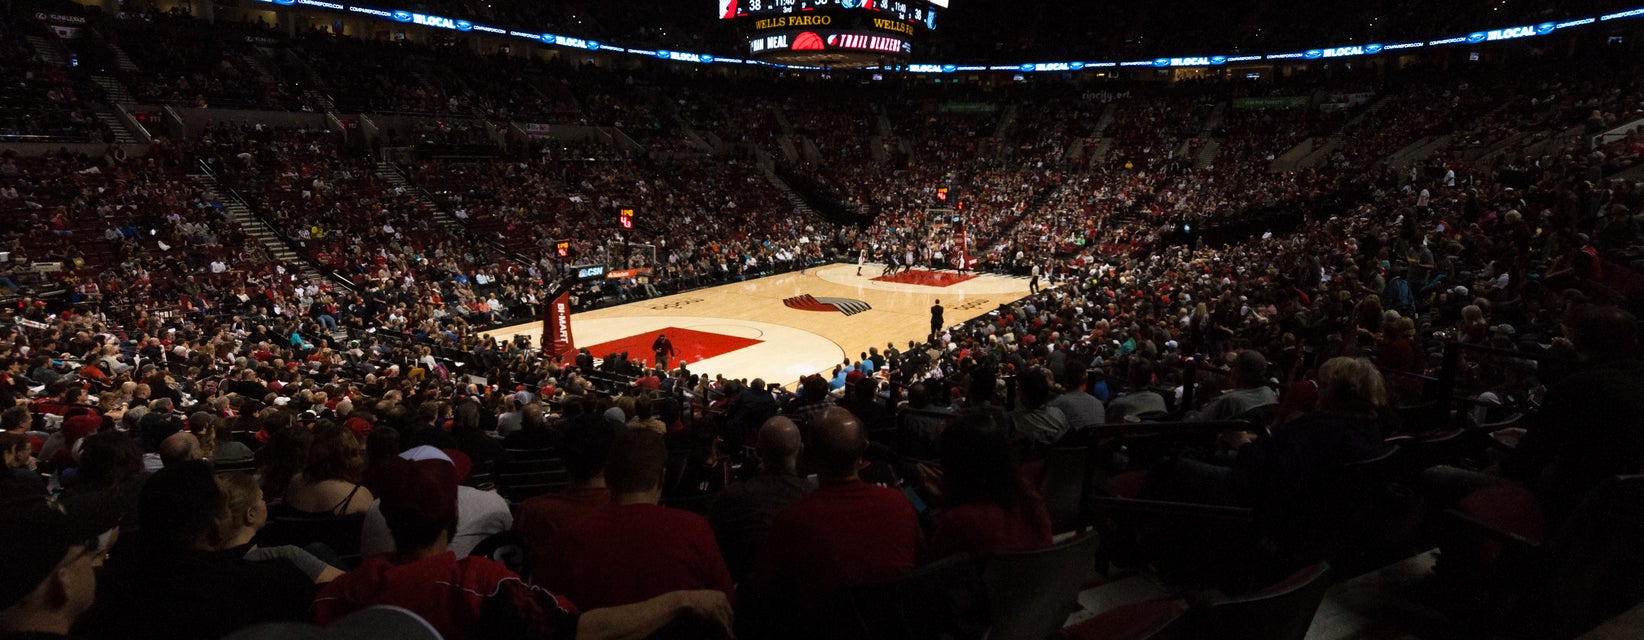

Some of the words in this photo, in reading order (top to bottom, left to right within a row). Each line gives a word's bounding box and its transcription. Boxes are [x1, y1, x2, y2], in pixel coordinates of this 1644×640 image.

[749, 0, 761, 11] 38
[422, 15, 456, 29] LOCAL
[755, 18, 786, 30] WELLS
[788, 15, 831, 26] FARGO
[873, 18, 906, 33] WELLS
[1496, 26, 1536, 39] LOCAL
[766, 35, 788, 49] MEAL
[839, 34, 869, 48] TRAIL
[870, 36, 901, 52] BLAZERS
[1182, 56, 1210, 66] LOCAL
[1331, 46, 1364, 57] LOCAL
[588, 266, 603, 277] CSN
